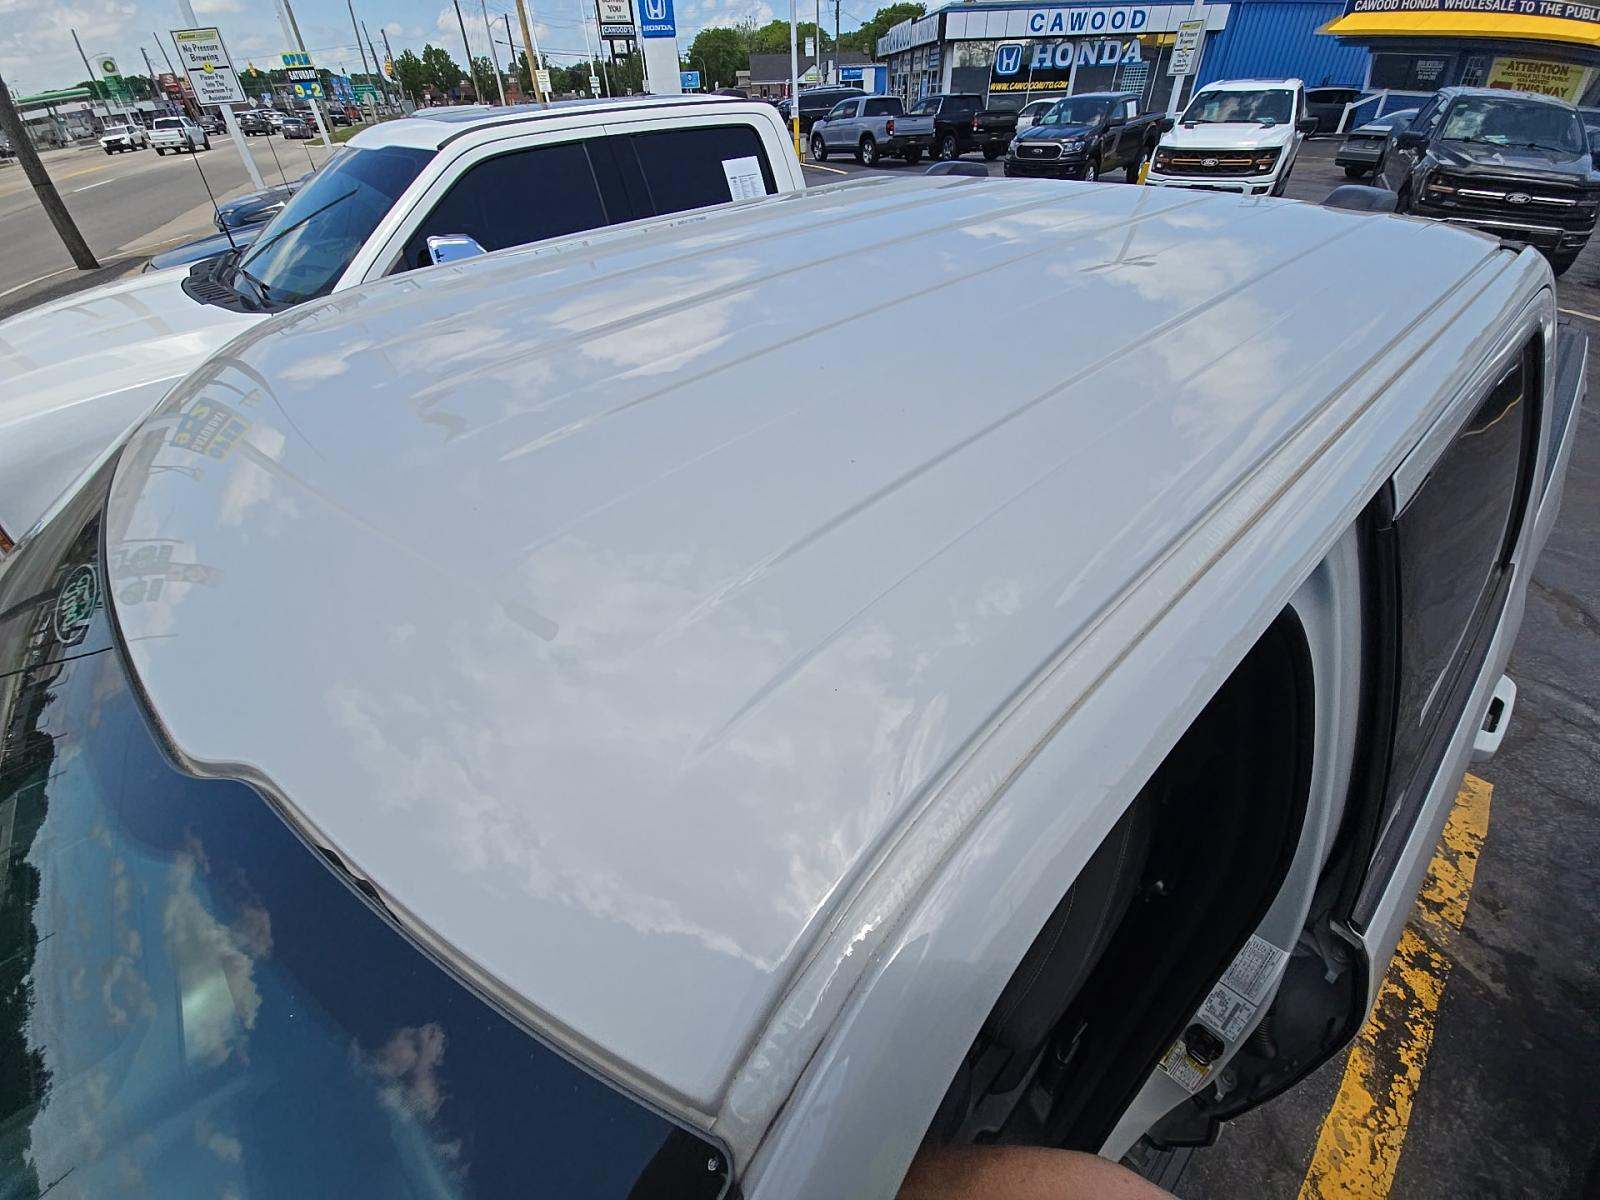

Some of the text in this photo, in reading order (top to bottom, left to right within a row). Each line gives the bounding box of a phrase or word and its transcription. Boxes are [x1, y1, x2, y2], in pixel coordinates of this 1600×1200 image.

[1355, 0, 1398, 11] CAWOOD
[1401, 0, 1439, 9] HONDA
[1444, 0, 1517, 11] WHOLESALE
[1520, 0, 1535, 12] TO
[1539, 2, 1563, 16] THE
[643, 24, 674, 32] HONDA
[1030, 10, 1147, 32] CAWOOD
[282, 53, 312, 66] OPEN
[1030, 39, 1143, 69] HONDA
[288, 69, 317, 80] SATURDAY
[1506, 60, 1570, 76] ATTENTION
[1542, 86, 1569, 97] WAY
